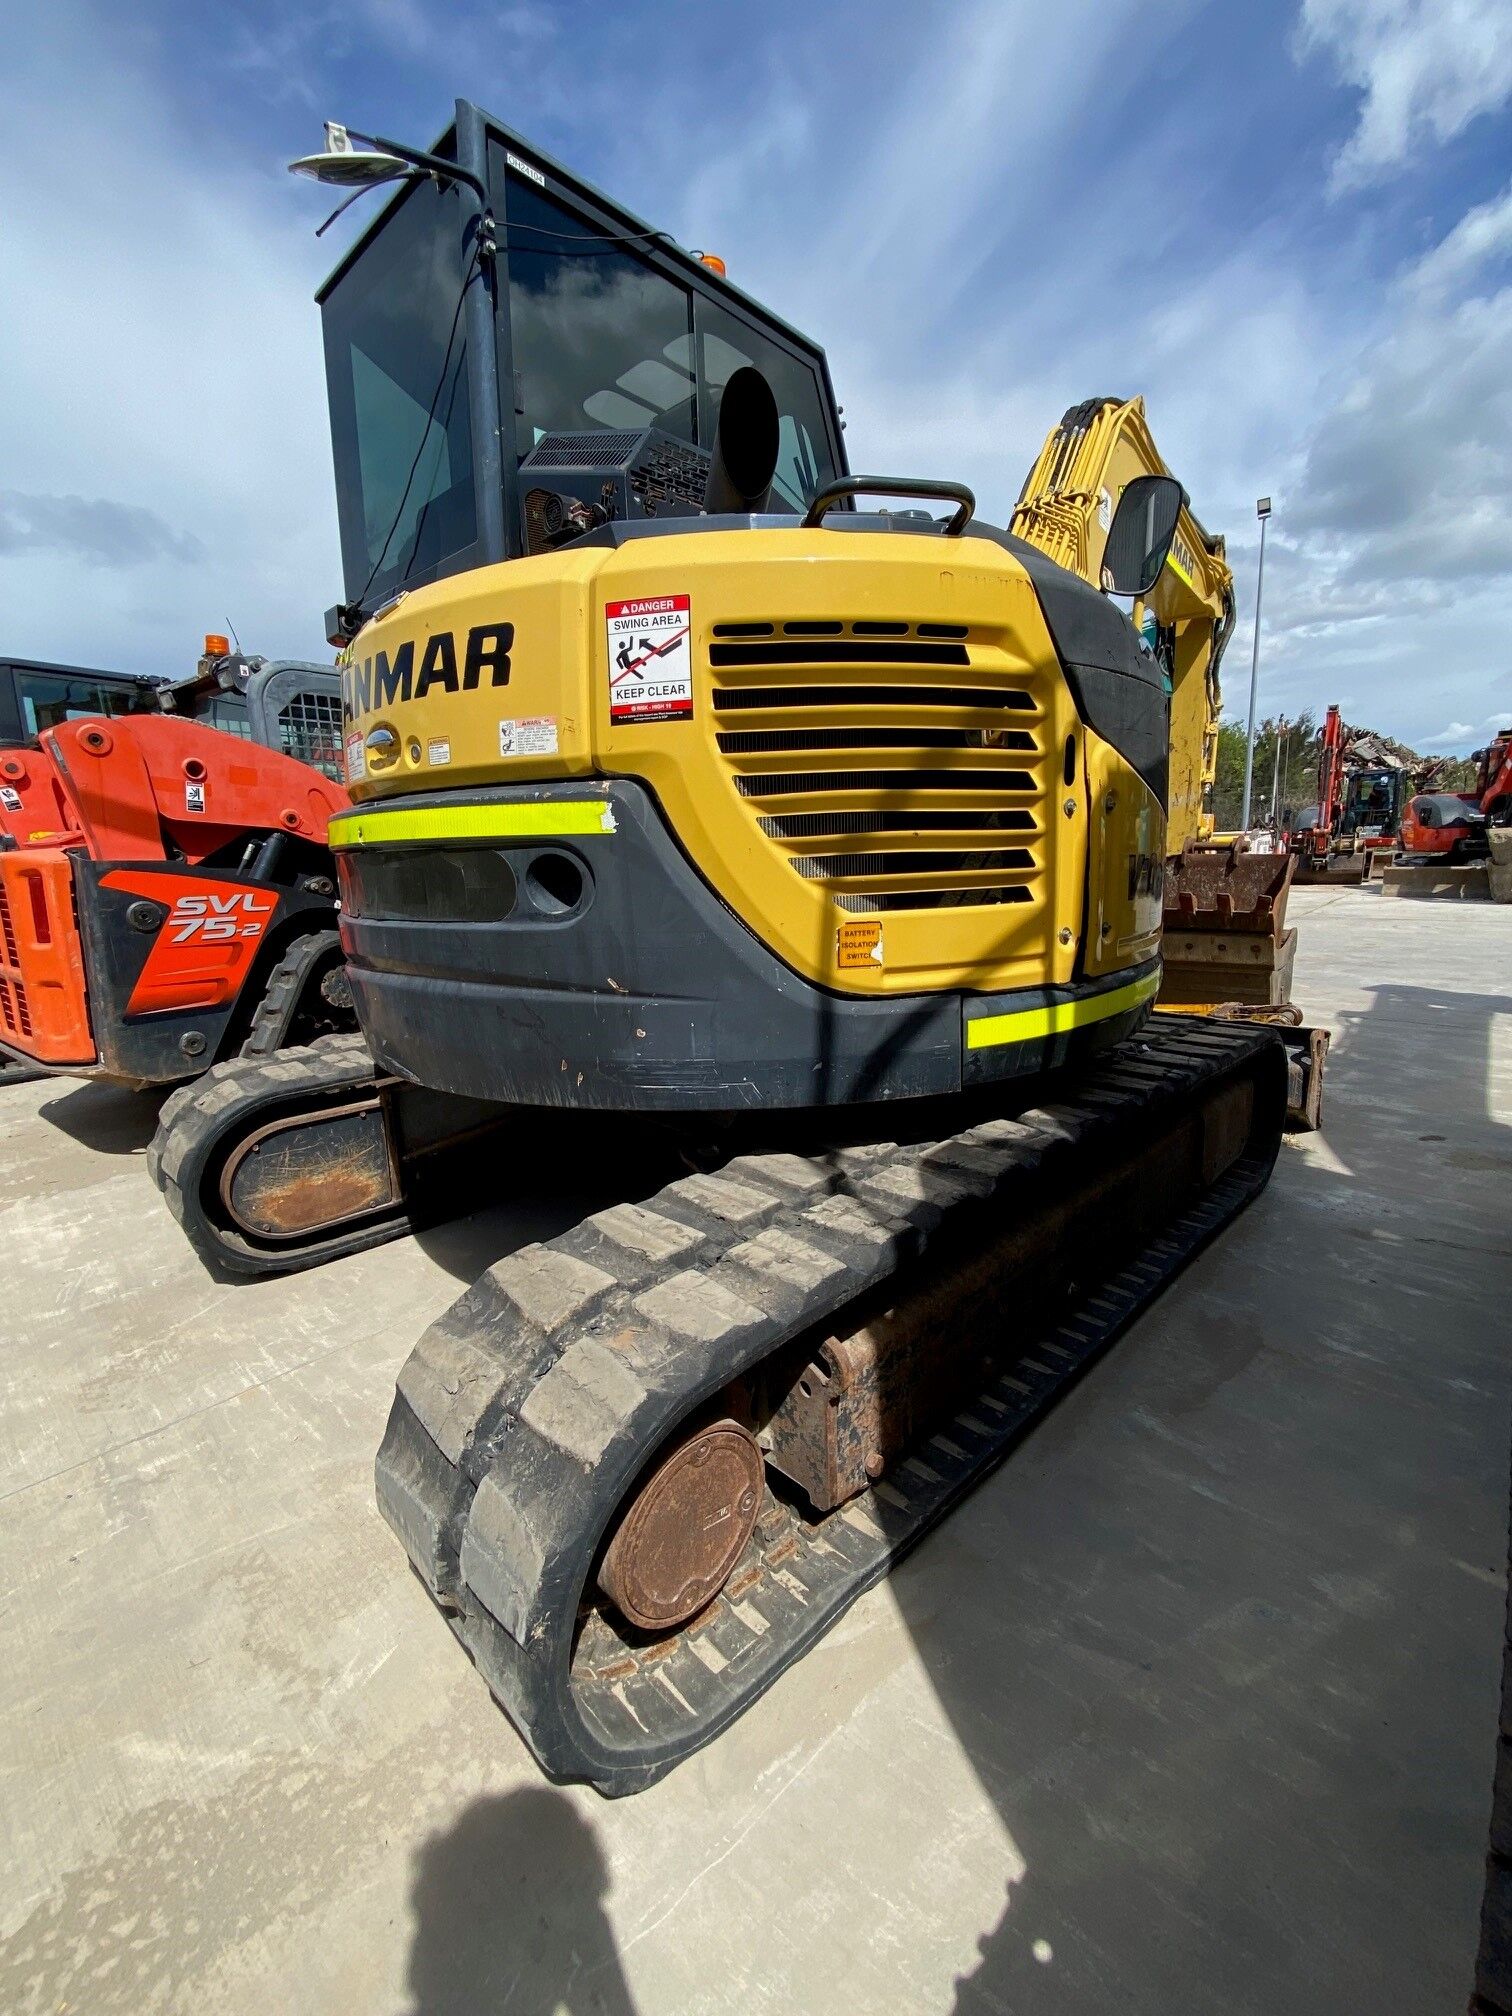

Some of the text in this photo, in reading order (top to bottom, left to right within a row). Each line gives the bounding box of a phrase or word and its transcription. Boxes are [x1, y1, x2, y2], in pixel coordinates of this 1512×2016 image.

[630, 600, 674, 613] DANGER
[614, 615, 682, 630] SWING AREA
[616, 684, 686, 699] KEEP CLEAR
[173, 893, 271, 917] SVL
[168, 916, 262, 943] 75-2
